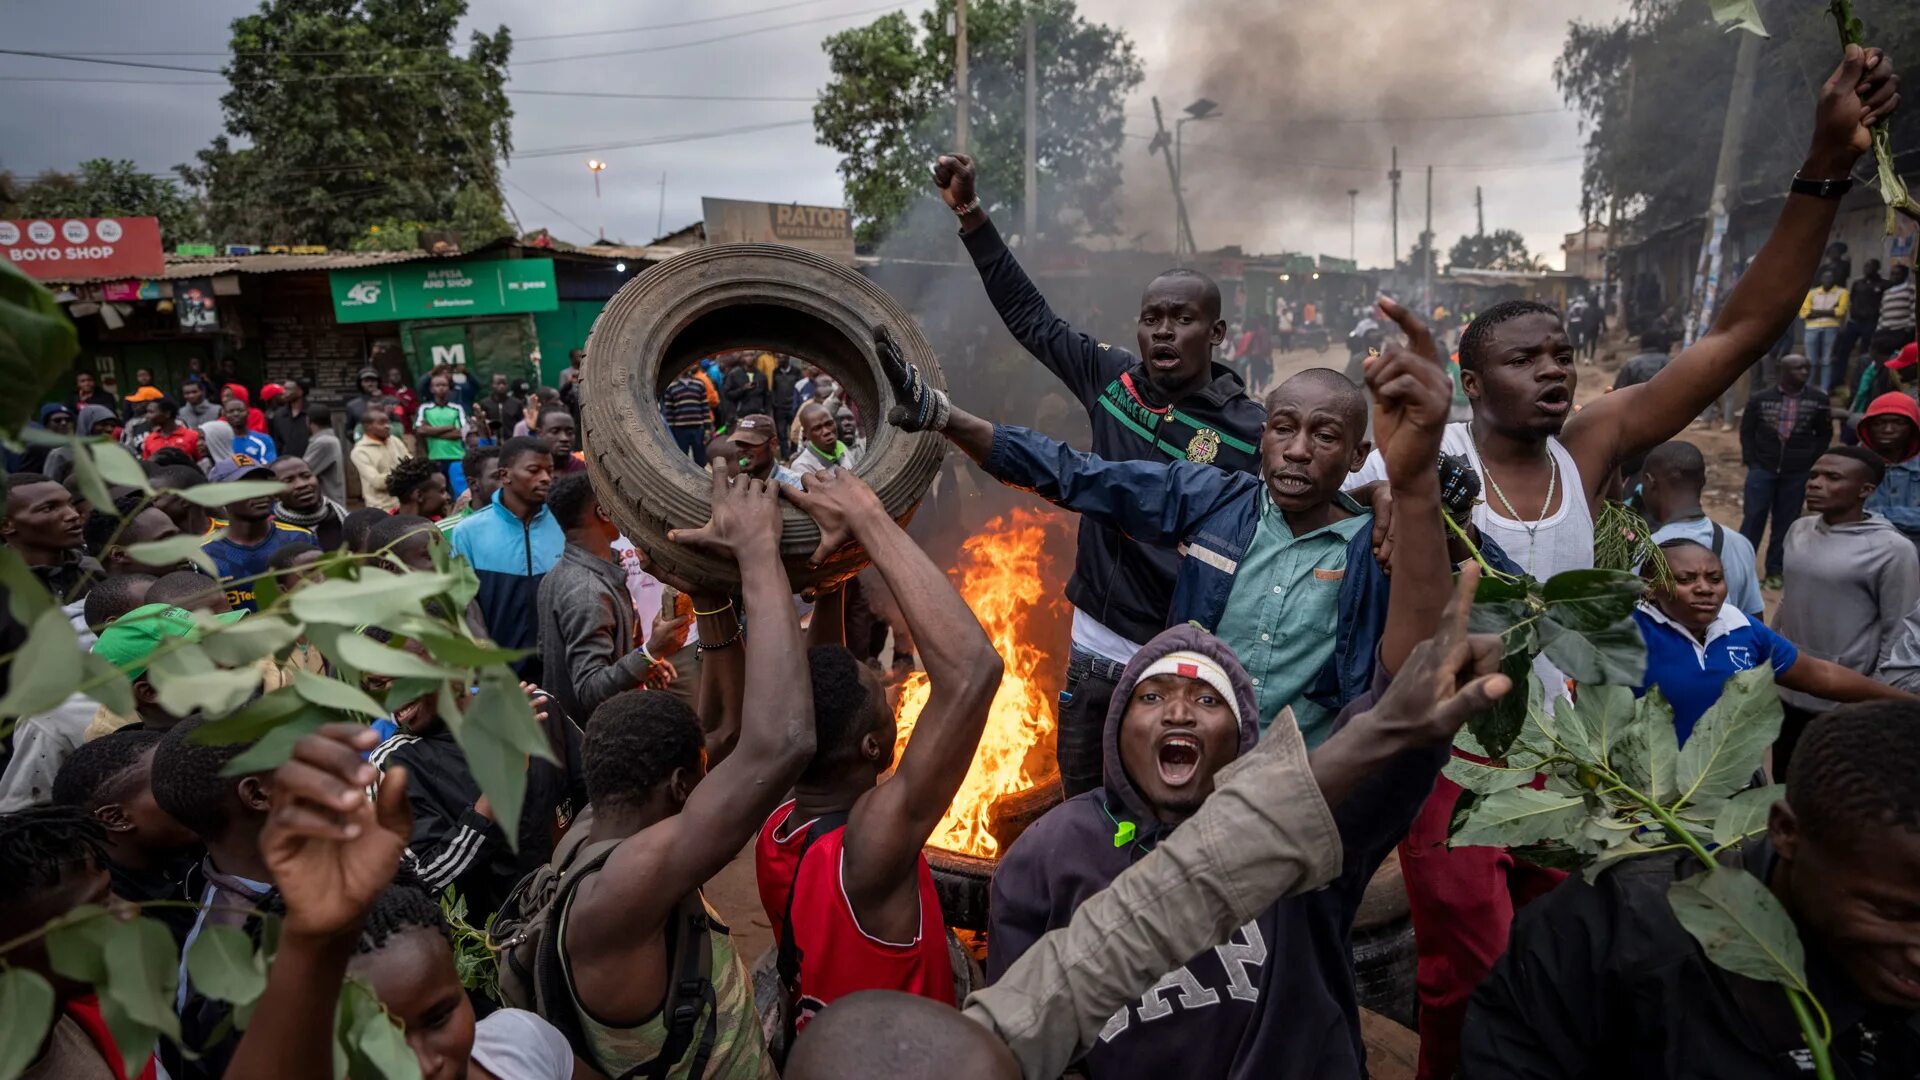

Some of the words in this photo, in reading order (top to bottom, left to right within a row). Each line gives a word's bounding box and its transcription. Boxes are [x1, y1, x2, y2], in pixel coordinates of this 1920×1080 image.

[777, 206, 847, 228] RATOR
[777, 227, 846, 238] INVESTMENTS
[10, 247, 62, 261] BOYO
[65, 246, 114, 260] SHOP
[347, 282, 382, 305] 4G
[431, 343, 467, 368] M
[1099, 918, 1268, 1043] AN
